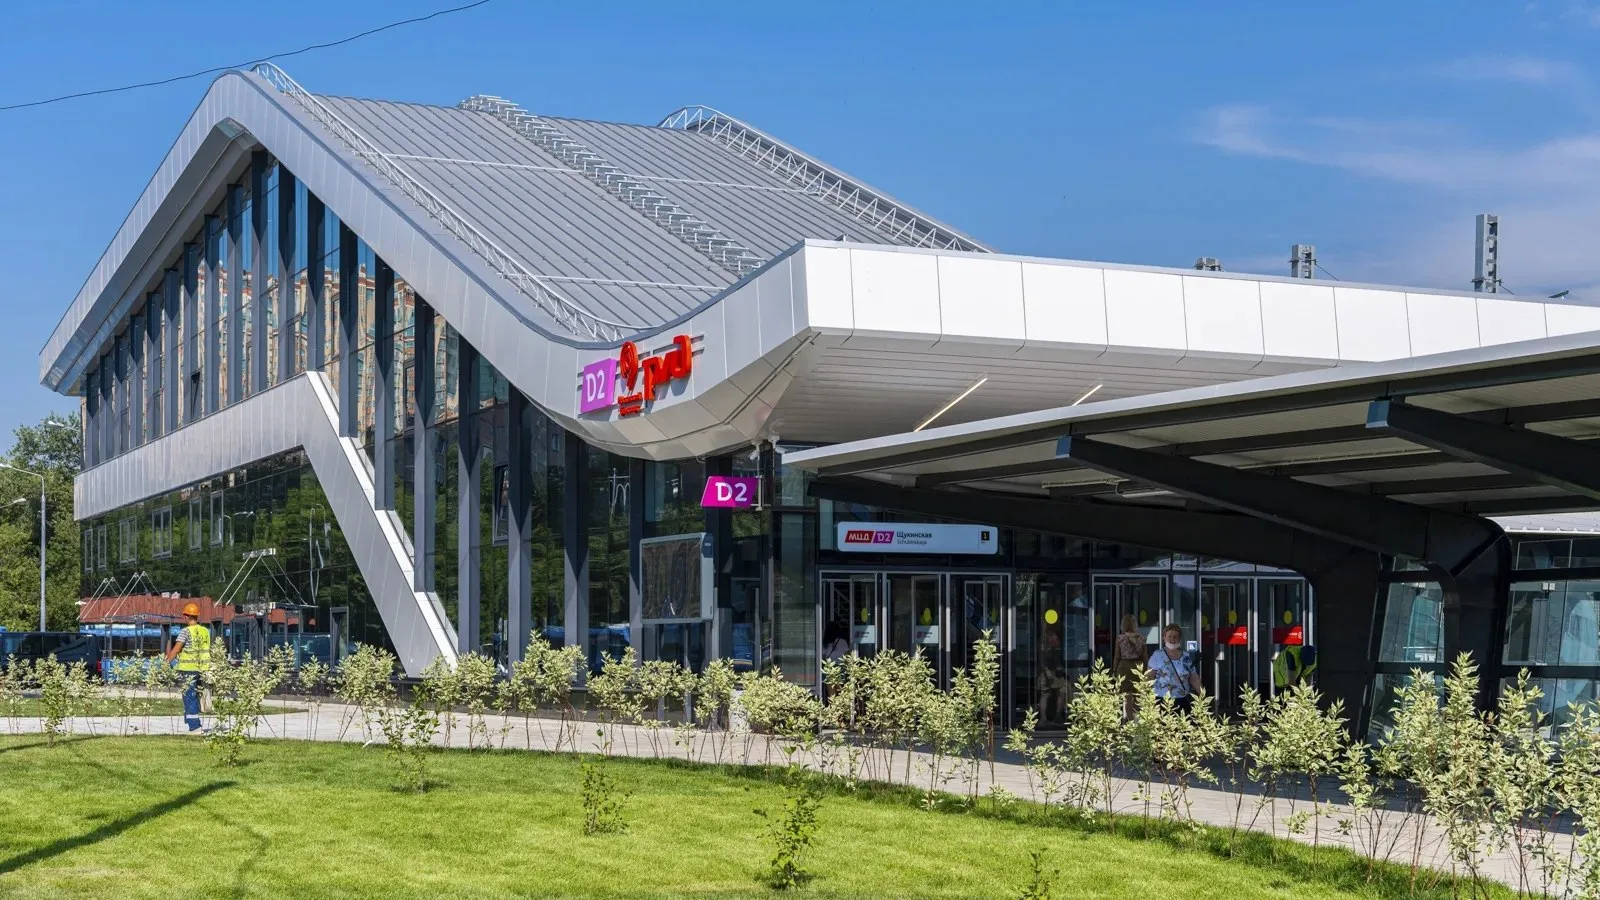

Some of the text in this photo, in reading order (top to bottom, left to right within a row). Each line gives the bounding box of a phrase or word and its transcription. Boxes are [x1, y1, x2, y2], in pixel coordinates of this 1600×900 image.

[586, 369, 606, 403] D2
[715, 482, 747, 502] D2
[848, 532, 891, 542] МЦД D2
[896, 531, 932, 539] Щукинская
